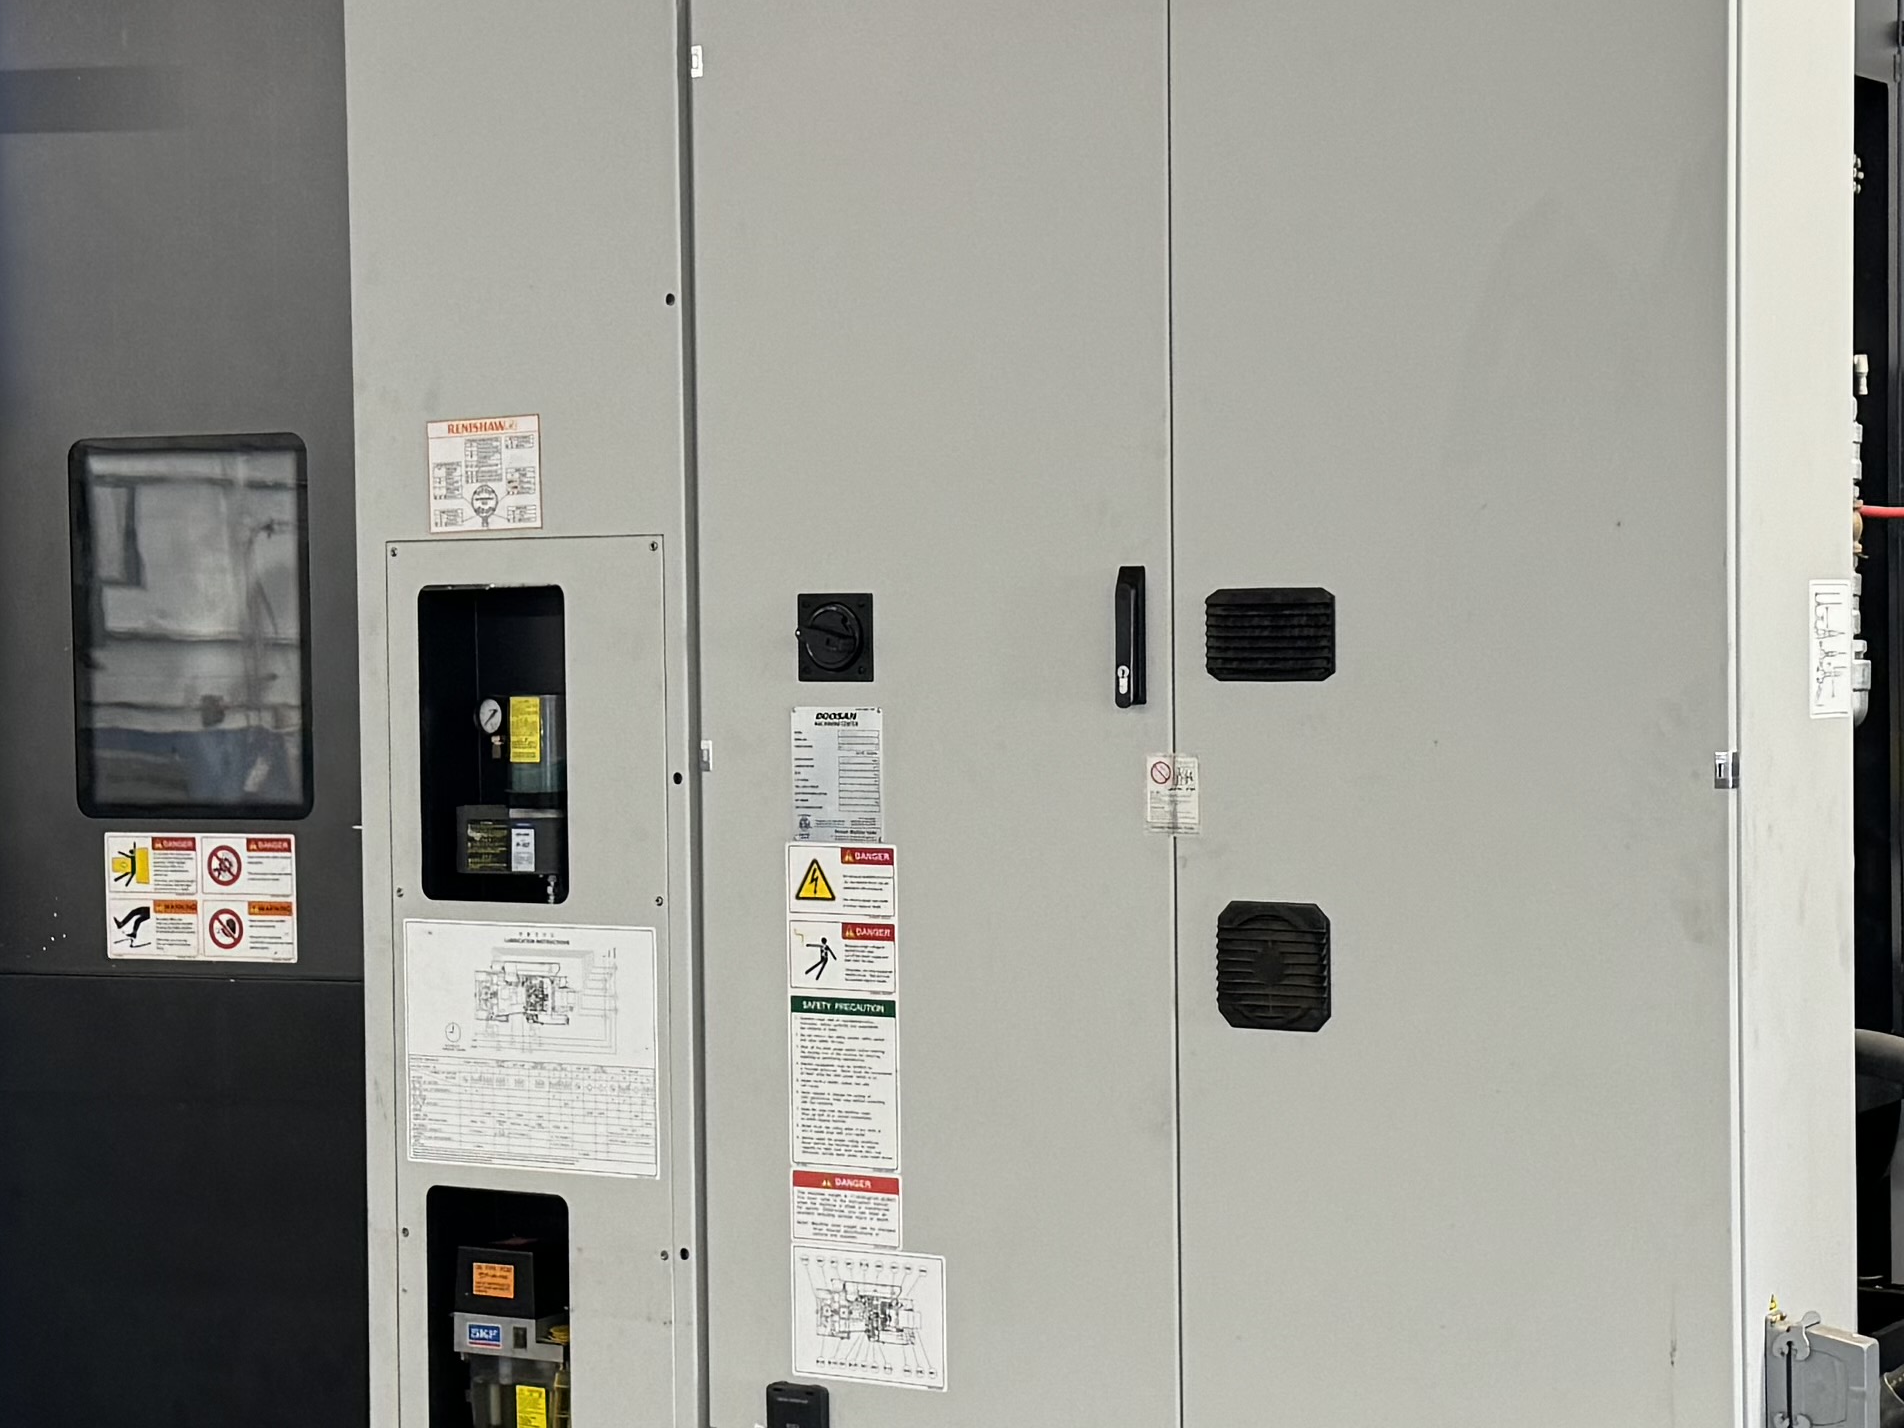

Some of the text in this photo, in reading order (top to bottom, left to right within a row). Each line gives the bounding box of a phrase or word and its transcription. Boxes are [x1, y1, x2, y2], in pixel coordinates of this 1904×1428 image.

[447, 420, 506, 435] RENISHAW
[815, 712, 857, 721] DOOSAN
[854, 851, 890, 861] DANGER
[855, 926, 891, 938] DANGER
[802, 1001, 885, 1014] SAFETY PRECAUTION
[834, 1177, 872, 1189] DANGER
[470, 1327, 499, 1340] SKF
